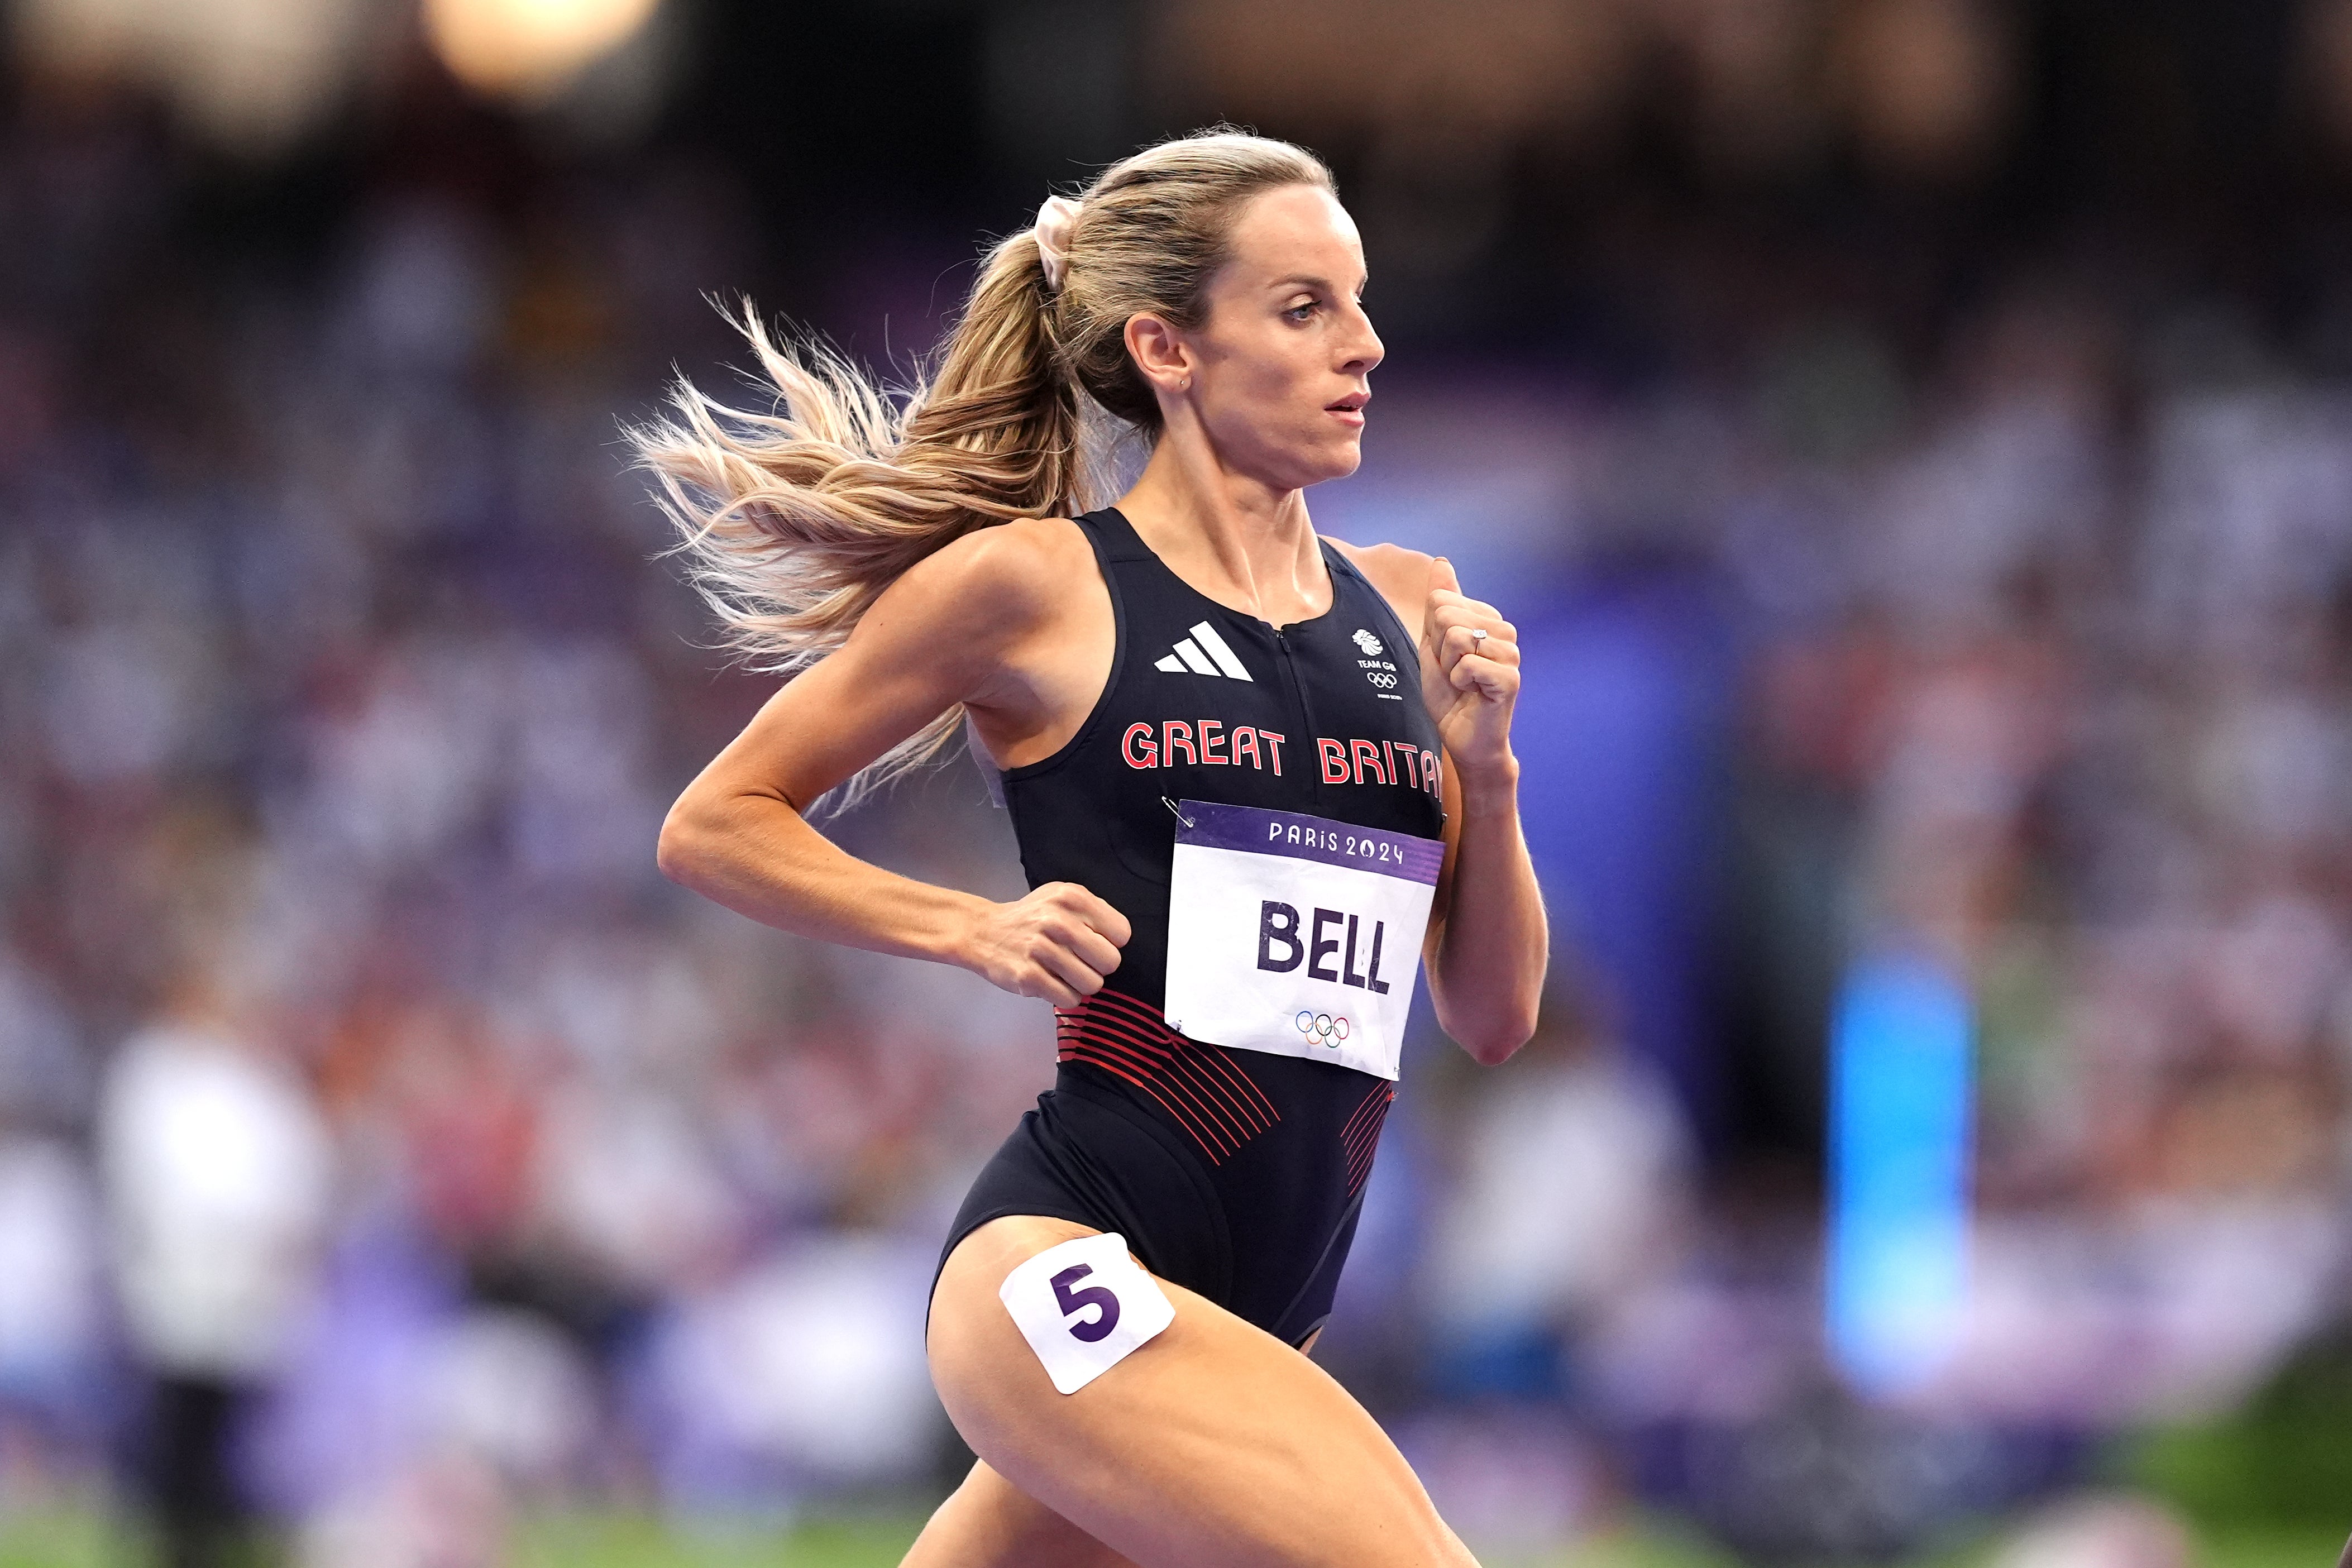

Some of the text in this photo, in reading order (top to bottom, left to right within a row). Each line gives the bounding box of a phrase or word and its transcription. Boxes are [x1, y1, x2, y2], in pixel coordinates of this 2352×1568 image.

[1357, 660, 1397, 671] TEAM GB
[1122, 720, 1284, 776] GREAT
[1346, 836, 1403, 864] 2024
[1257, 900, 1390, 995] BELL
[1050, 1263, 1120, 1342] 5
